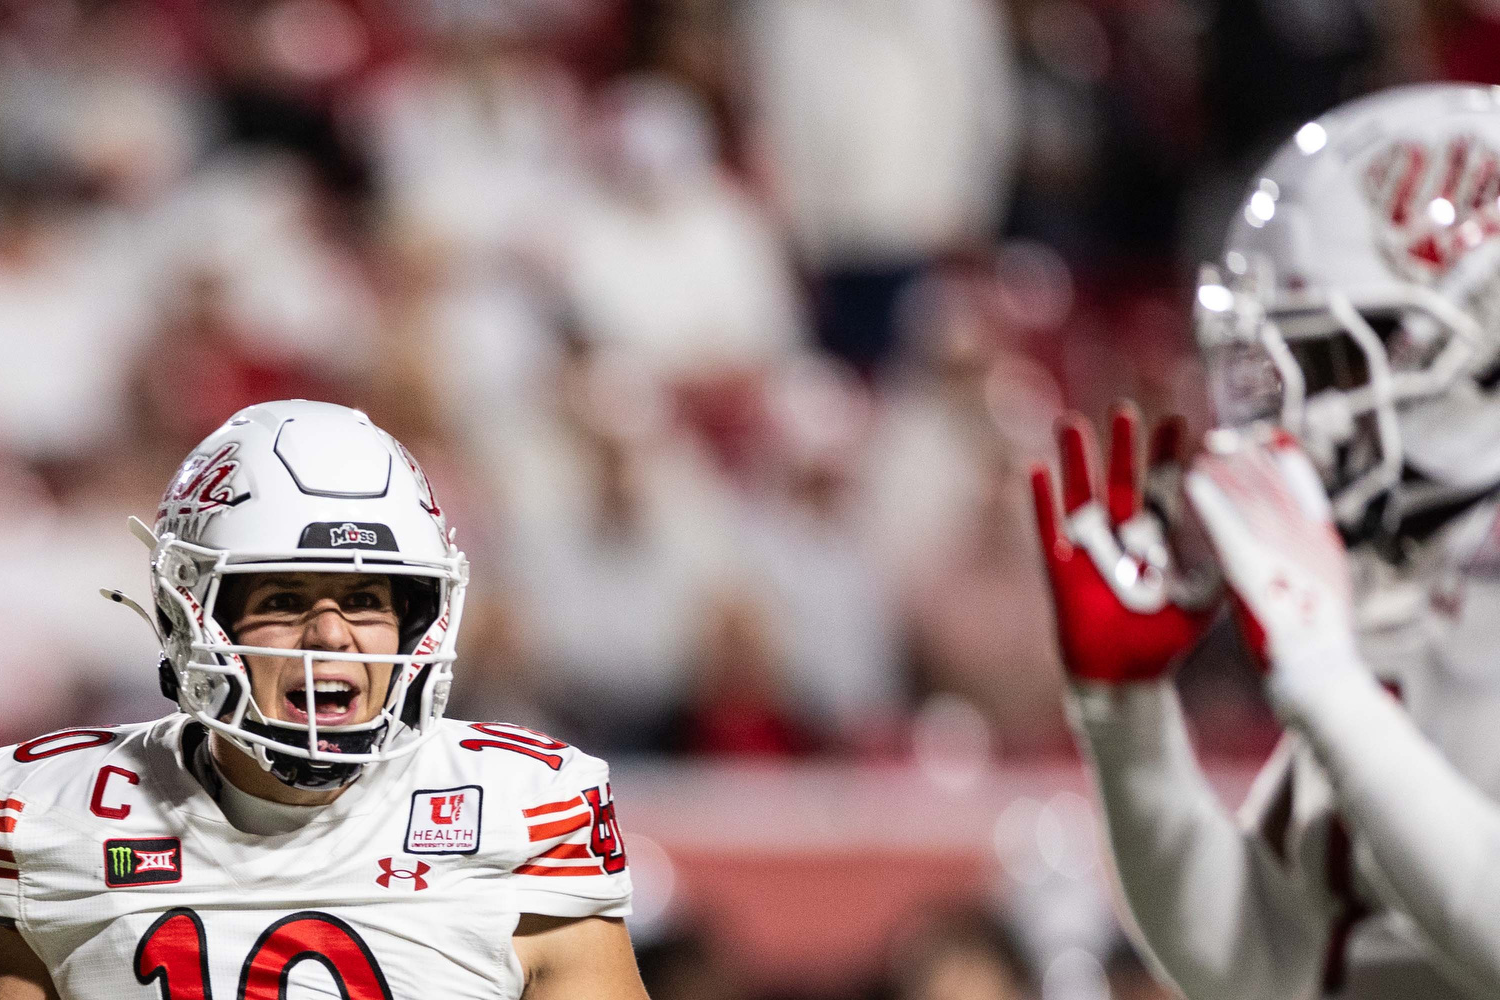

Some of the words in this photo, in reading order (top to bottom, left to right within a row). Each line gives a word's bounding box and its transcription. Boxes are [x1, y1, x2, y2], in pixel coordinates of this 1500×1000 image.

[460, 722, 569, 771] 10
[90, 765, 140, 820] C
[413, 829, 473, 841] HEALTH
[134, 851, 176, 871] XII
